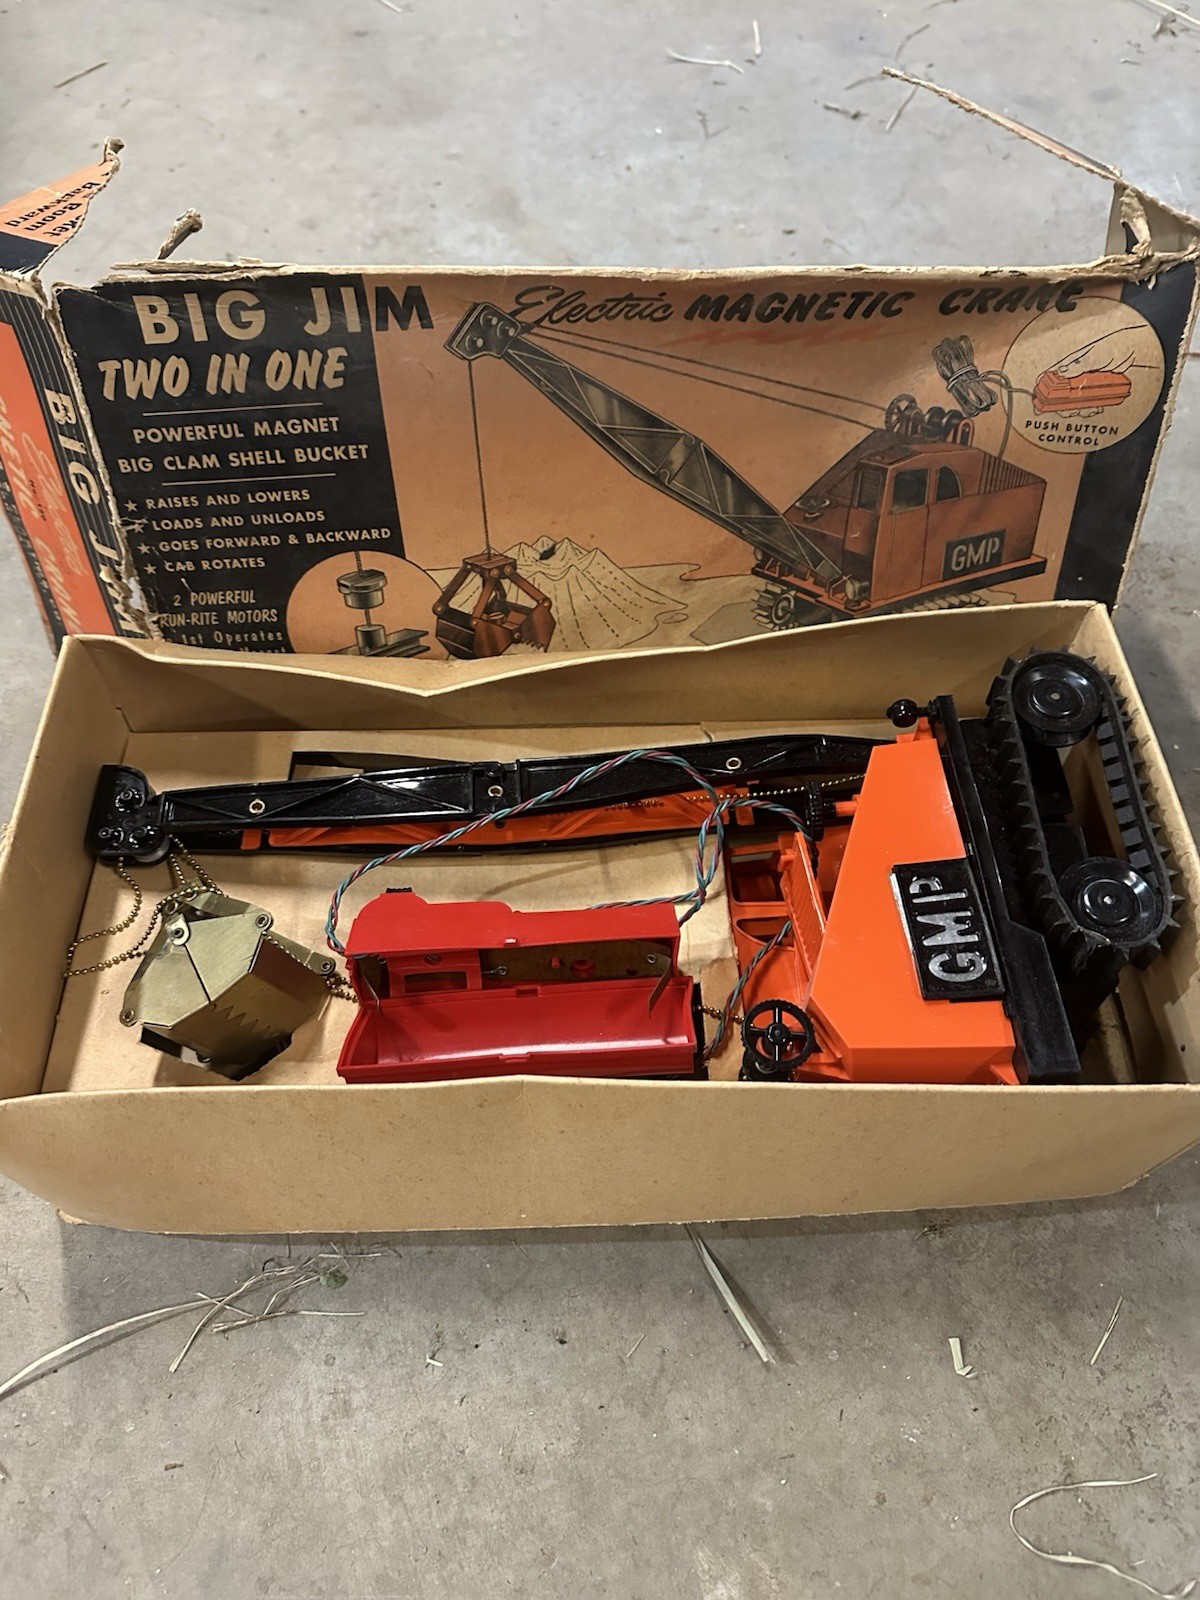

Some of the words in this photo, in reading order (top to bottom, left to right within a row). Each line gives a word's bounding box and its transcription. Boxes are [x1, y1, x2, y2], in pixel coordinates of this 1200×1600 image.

[5, 182, 101, 228] Backward
[24, 203, 83, 231] Boom
[132, 290, 266, 346] BIG
[304, 285, 434, 336] JIM
[505, 285, 674, 333] Electric
[684, 291, 915, 323] MAGNETIC
[98, 355, 190, 401] TWO
[206, 352, 250, 395] IN
[265, 346, 348, 392] ONE
[132, 423, 244, 445] POWERFUL
[253, 416, 340, 437] MAGNET
[1025, 420, 1059, 431] PUSH
[1066, 423, 1119, 435] BUTTON
[1038, 433, 1100, 446] CONTROL
[44, 388, 100, 505] BIG
[117, 457, 154, 474] BIG
[163, 453, 220, 472] CLAM
[229, 448, 286, 468] SHELL
[295, 444, 369, 463] BUCKET
[146, 496, 200, 511] RAISES
[206, 493, 241, 507] AND
[247, 489, 311, 504] LOWERS
[152, 517, 203, 532] LOADS
[210, 514, 245, 529] AND
[251, 510, 326, 526] UNLOADS
[158, 540, 200, 554] GOES
[205, 534, 281, 550] FORWARD
[288, 533, 300, 545] &
[306, 526, 392, 545] BACKWARD
[165, 562, 196, 573] CAB
[201, 556, 266, 570] ROTATES
[951, 537, 1001, 572] GMP
[173, 594, 182, 607] 2
[190, 590, 257, 607] POWERFUL
[159, 611, 220, 629] RUN-RITE
[227, 608, 279, 625] MOTORS
[181, 632, 204, 645] 1st
[213, 629, 284, 646] Operates
[909, 875, 988, 983] GMP
